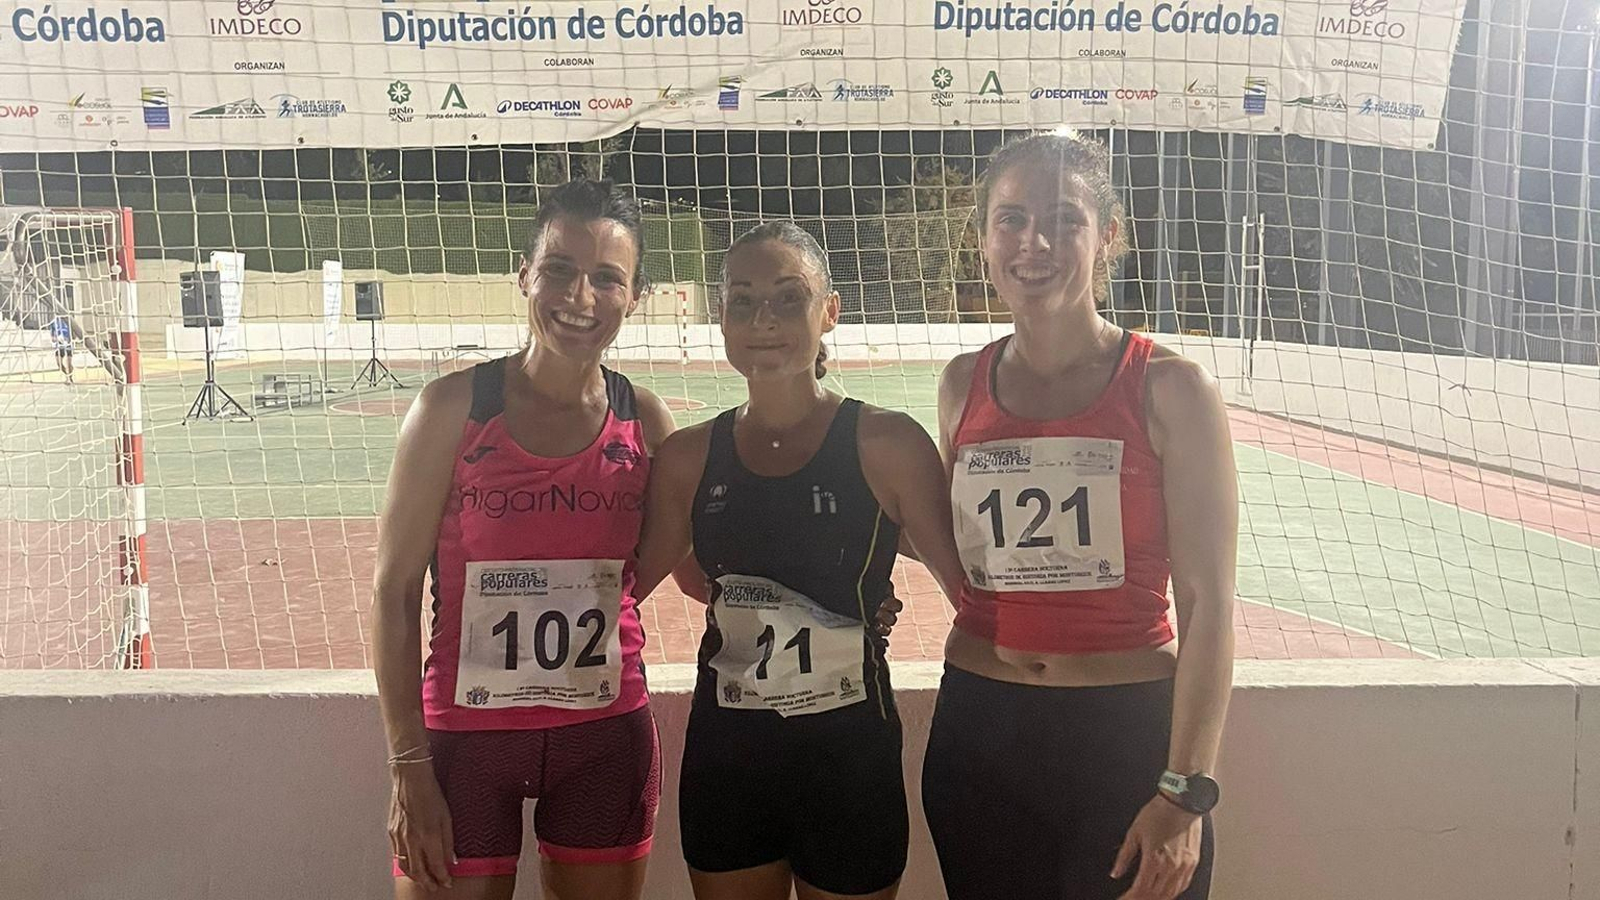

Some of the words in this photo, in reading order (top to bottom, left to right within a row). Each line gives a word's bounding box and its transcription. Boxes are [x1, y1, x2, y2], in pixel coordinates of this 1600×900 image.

[783, 7, 862, 26] IMDECO
[934, 0, 1095, 38] Diputación
[1105, 1, 1142, 33] de
[1152, 1, 1279, 36] Córdoba
[12, 4, 166, 42] Córdoba
[210, 18, 301, 35] IMDECO
[381, 6, 555, 49] Diputación
[567, 8, 605, 40] de
[615, 4, 743, 39] Córdoba
[1319, 16, 1405, 39] IMDECO
[800, 48, 843, 56] ORGANIZAN
[1078, 49, 1126, 57] COLABORAN
[234, 62, 285, 71] ORGANIZAN
[544, 57, 594, 66] COLABORAN
[1331, 58, 1379, 70] ORGANIZAN
[846, 89, 894, 97] TROTASIERRA
[1045, 89, 1108, 99] DECATHLON
[1115, 89, 1158, 100] COVAP
[293, 104, 346, 113] TROTASIERRA
[514, 100, 580, 111] DECATHLON
[588, 98, 633, 110] COVAP
[0, 105, 39, 118] OVAP
[978, 486, 1091, 548] 121
[481, 572, 538, 581] carreras
[481, 578, 548, 591] populares
[492, 608, 607, 671] 102
[756, 624, 812, 680] 11
